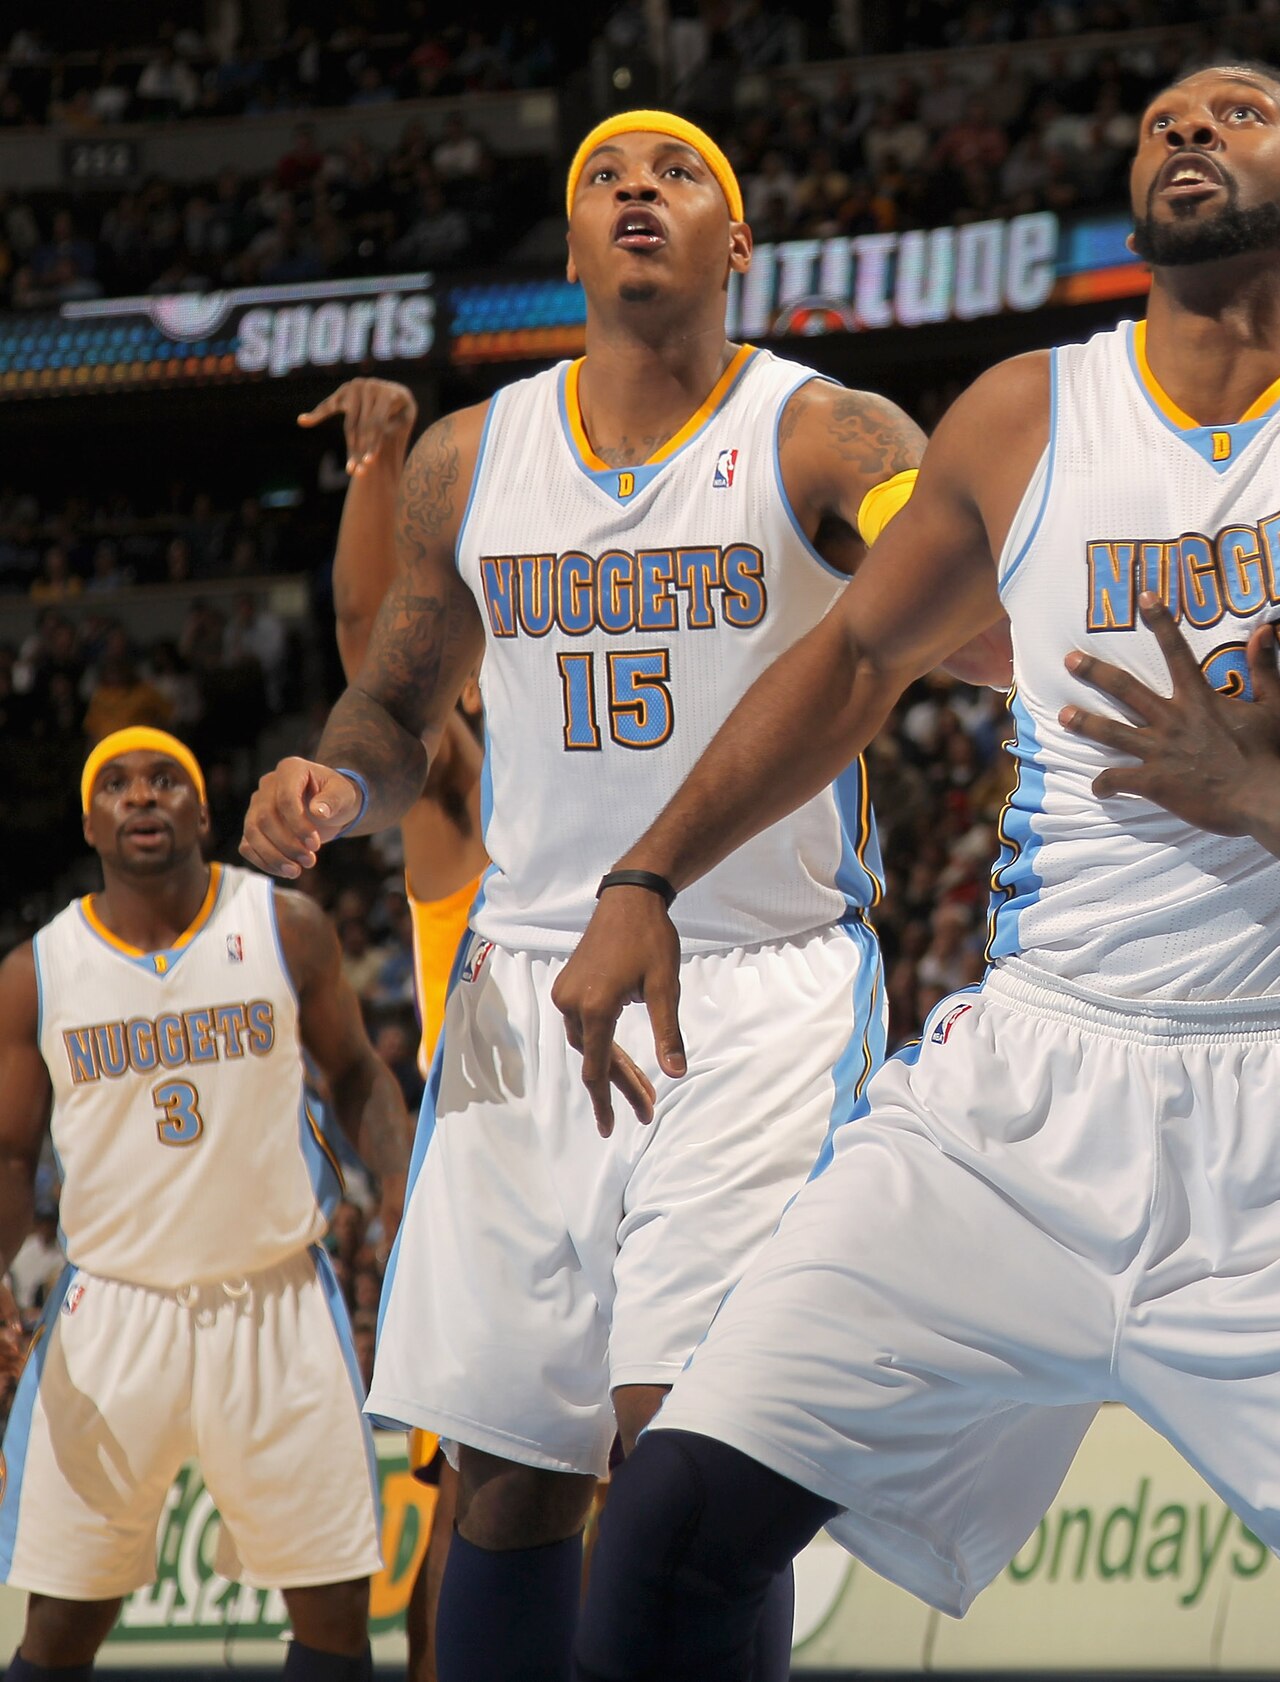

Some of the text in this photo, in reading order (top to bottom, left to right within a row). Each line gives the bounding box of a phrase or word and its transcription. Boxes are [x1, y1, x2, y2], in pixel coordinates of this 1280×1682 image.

[235, 290, 436, 379] sports
[618, 472, 635, 498] D
[1212, 431, 1232, 462] D
[480, 542, 767, 638] NUGGETS
[556, 648, 675, 752] 15
[62, 998, 276, 1086] NUGGETS
[152, 1078, 204, 1148] 3
[1008, 1477, 1272, 1608] ondays
